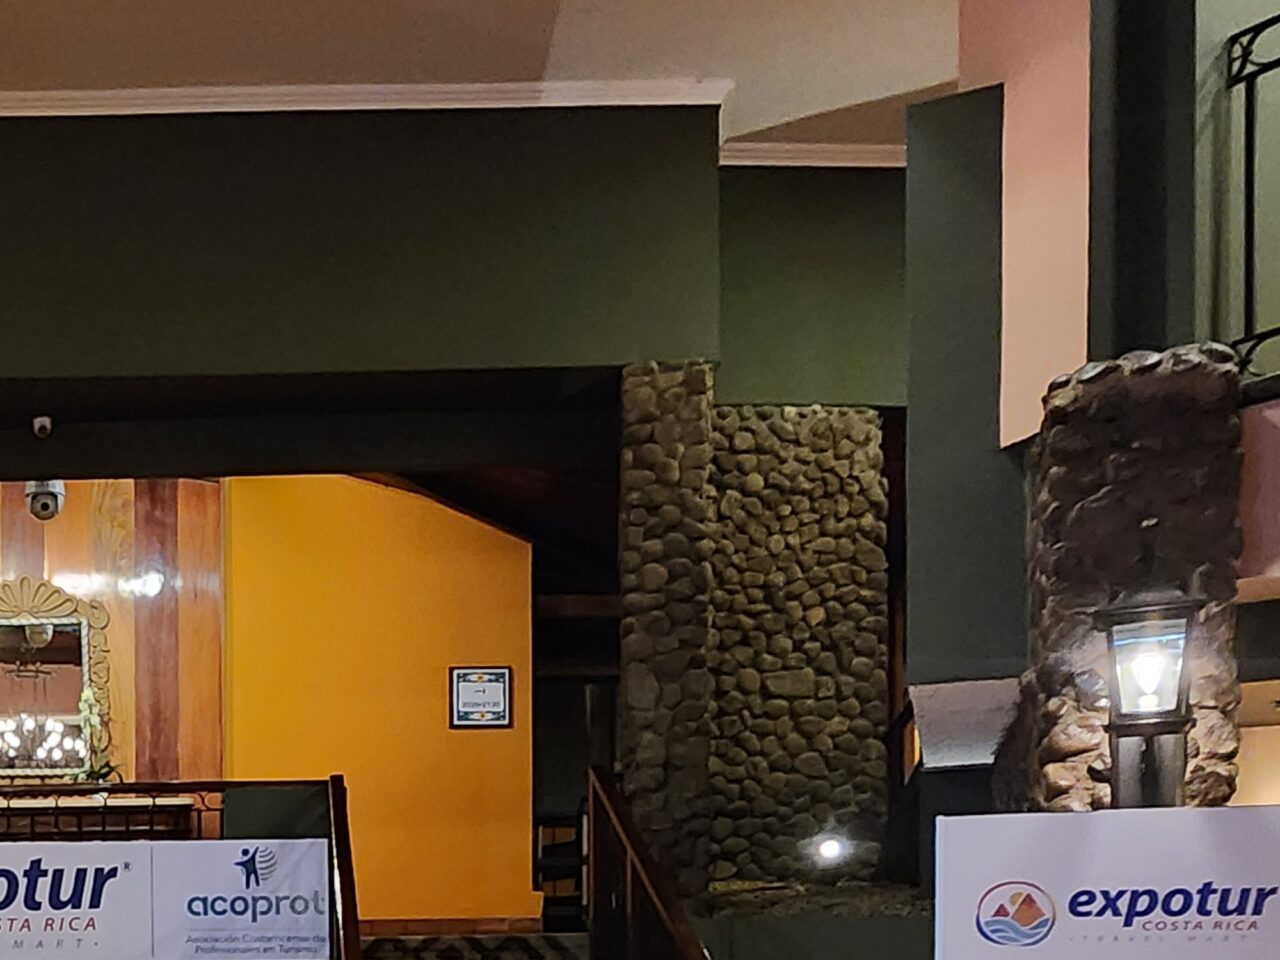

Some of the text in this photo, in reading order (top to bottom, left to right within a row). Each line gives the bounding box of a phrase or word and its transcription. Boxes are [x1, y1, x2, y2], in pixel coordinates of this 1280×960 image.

[187, 890, 326, 923] acoprot
[1068, 881, 1279, 928] expotur
[43, 916, 97, 932] RICA
[1141, 919, 1259, 932] COSTA RICA
[11, 937, 86, 949] MART
